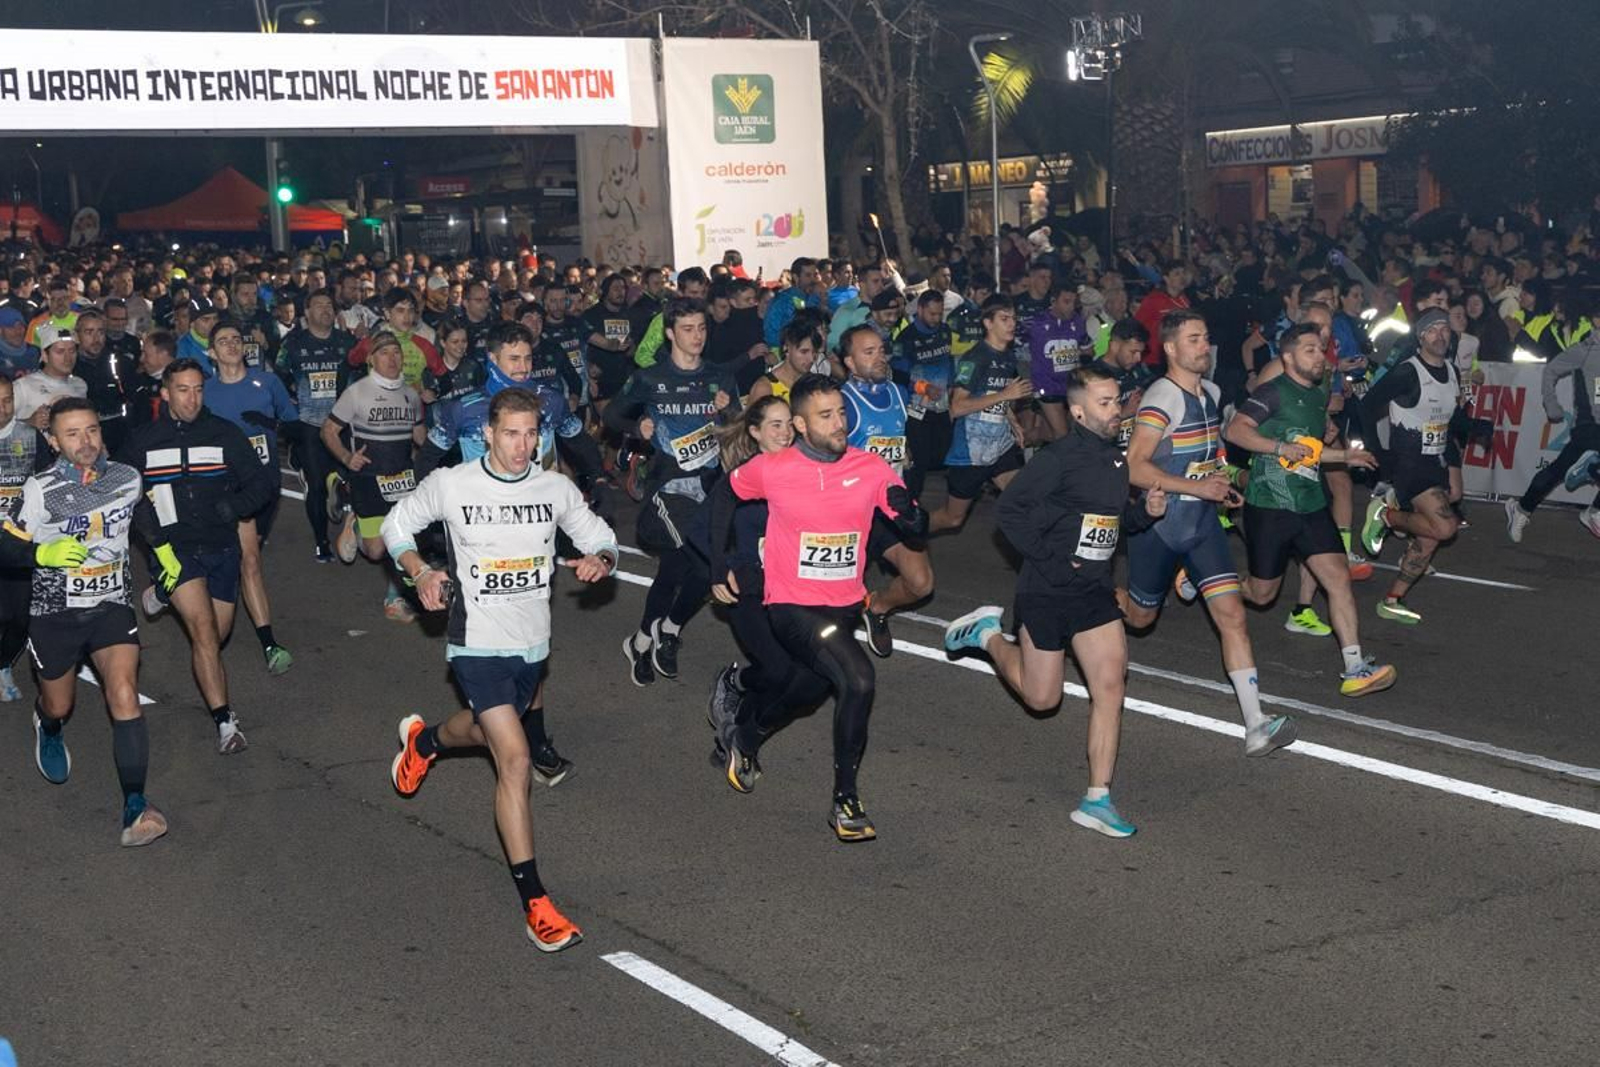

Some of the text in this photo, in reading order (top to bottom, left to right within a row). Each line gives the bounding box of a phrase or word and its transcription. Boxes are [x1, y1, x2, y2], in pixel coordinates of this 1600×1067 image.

[28, 69, 139, 101] URBANA
[146, 69, 367, 101] INTERNACIONAL
[374, 70, 452, 100] NOCHE
[458, 70, 488, 100] DE
[495, 70, 537, 100] SAN
[718, 116, 770, 125] CAJA RURAL
[657, 400, 716, 415] SAN ANTÓ
[381, 480, 415, 492] 10016
[806, 546, 854, 562] 7215
[72, 571, 117, 592] 9451
[485, 569, 541, 589] 8651
